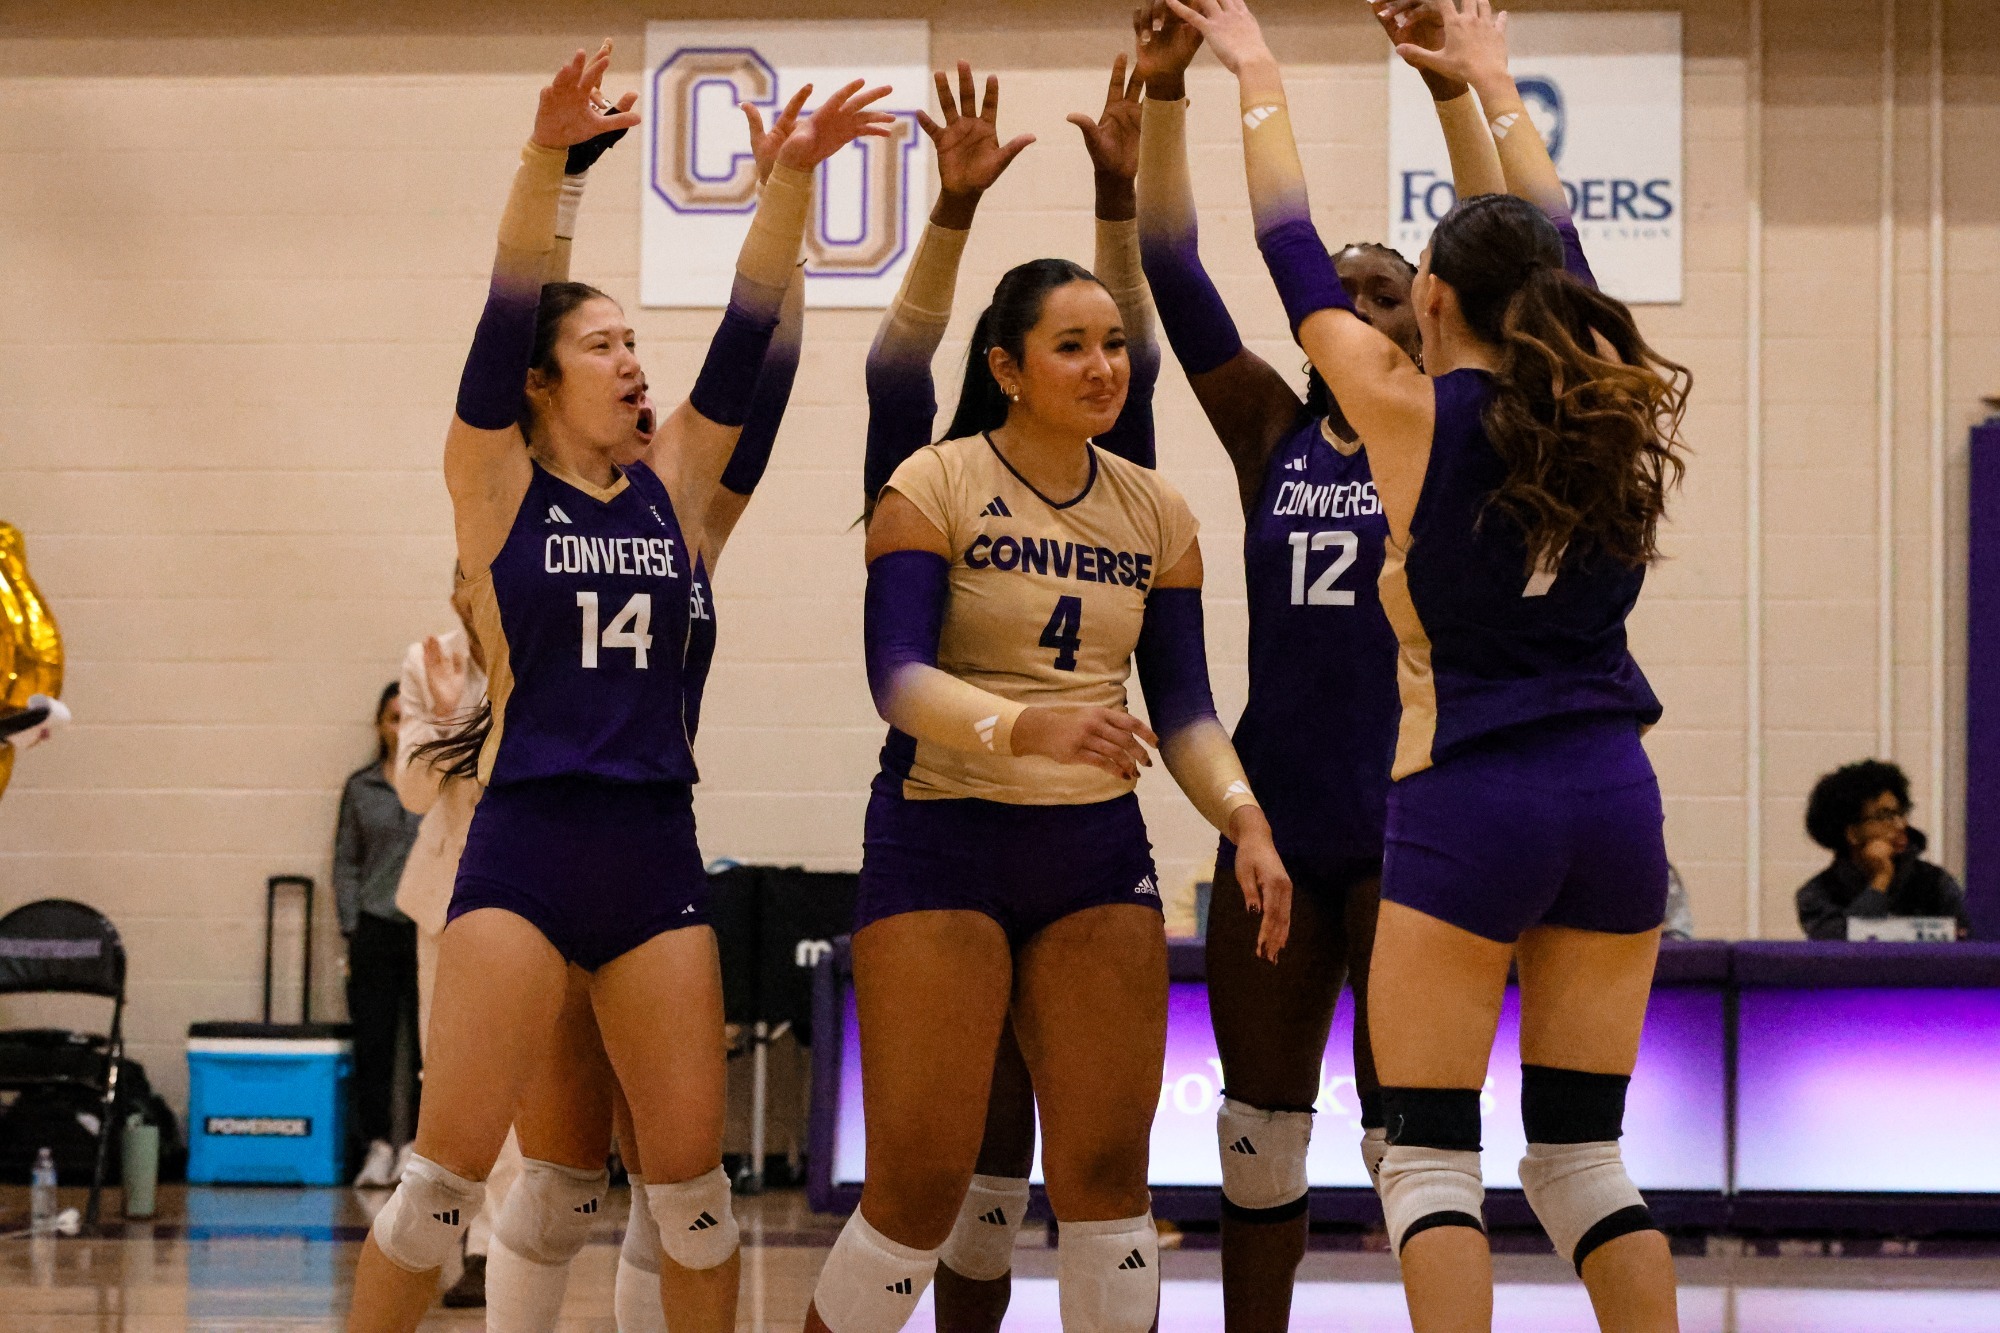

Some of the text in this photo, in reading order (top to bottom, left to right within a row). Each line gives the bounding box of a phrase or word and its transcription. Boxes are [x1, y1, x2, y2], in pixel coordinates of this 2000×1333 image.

[1272, 480, 1384, 518] CONVERS
[545, 534, 679, 579] CONVERSE
[964, 534, 1153, 591] CONVERSE
[1288, 530, 1359, 606] 12
[576, 591, 653, 670] 14
[1039, 595, 1082, 672] 4
